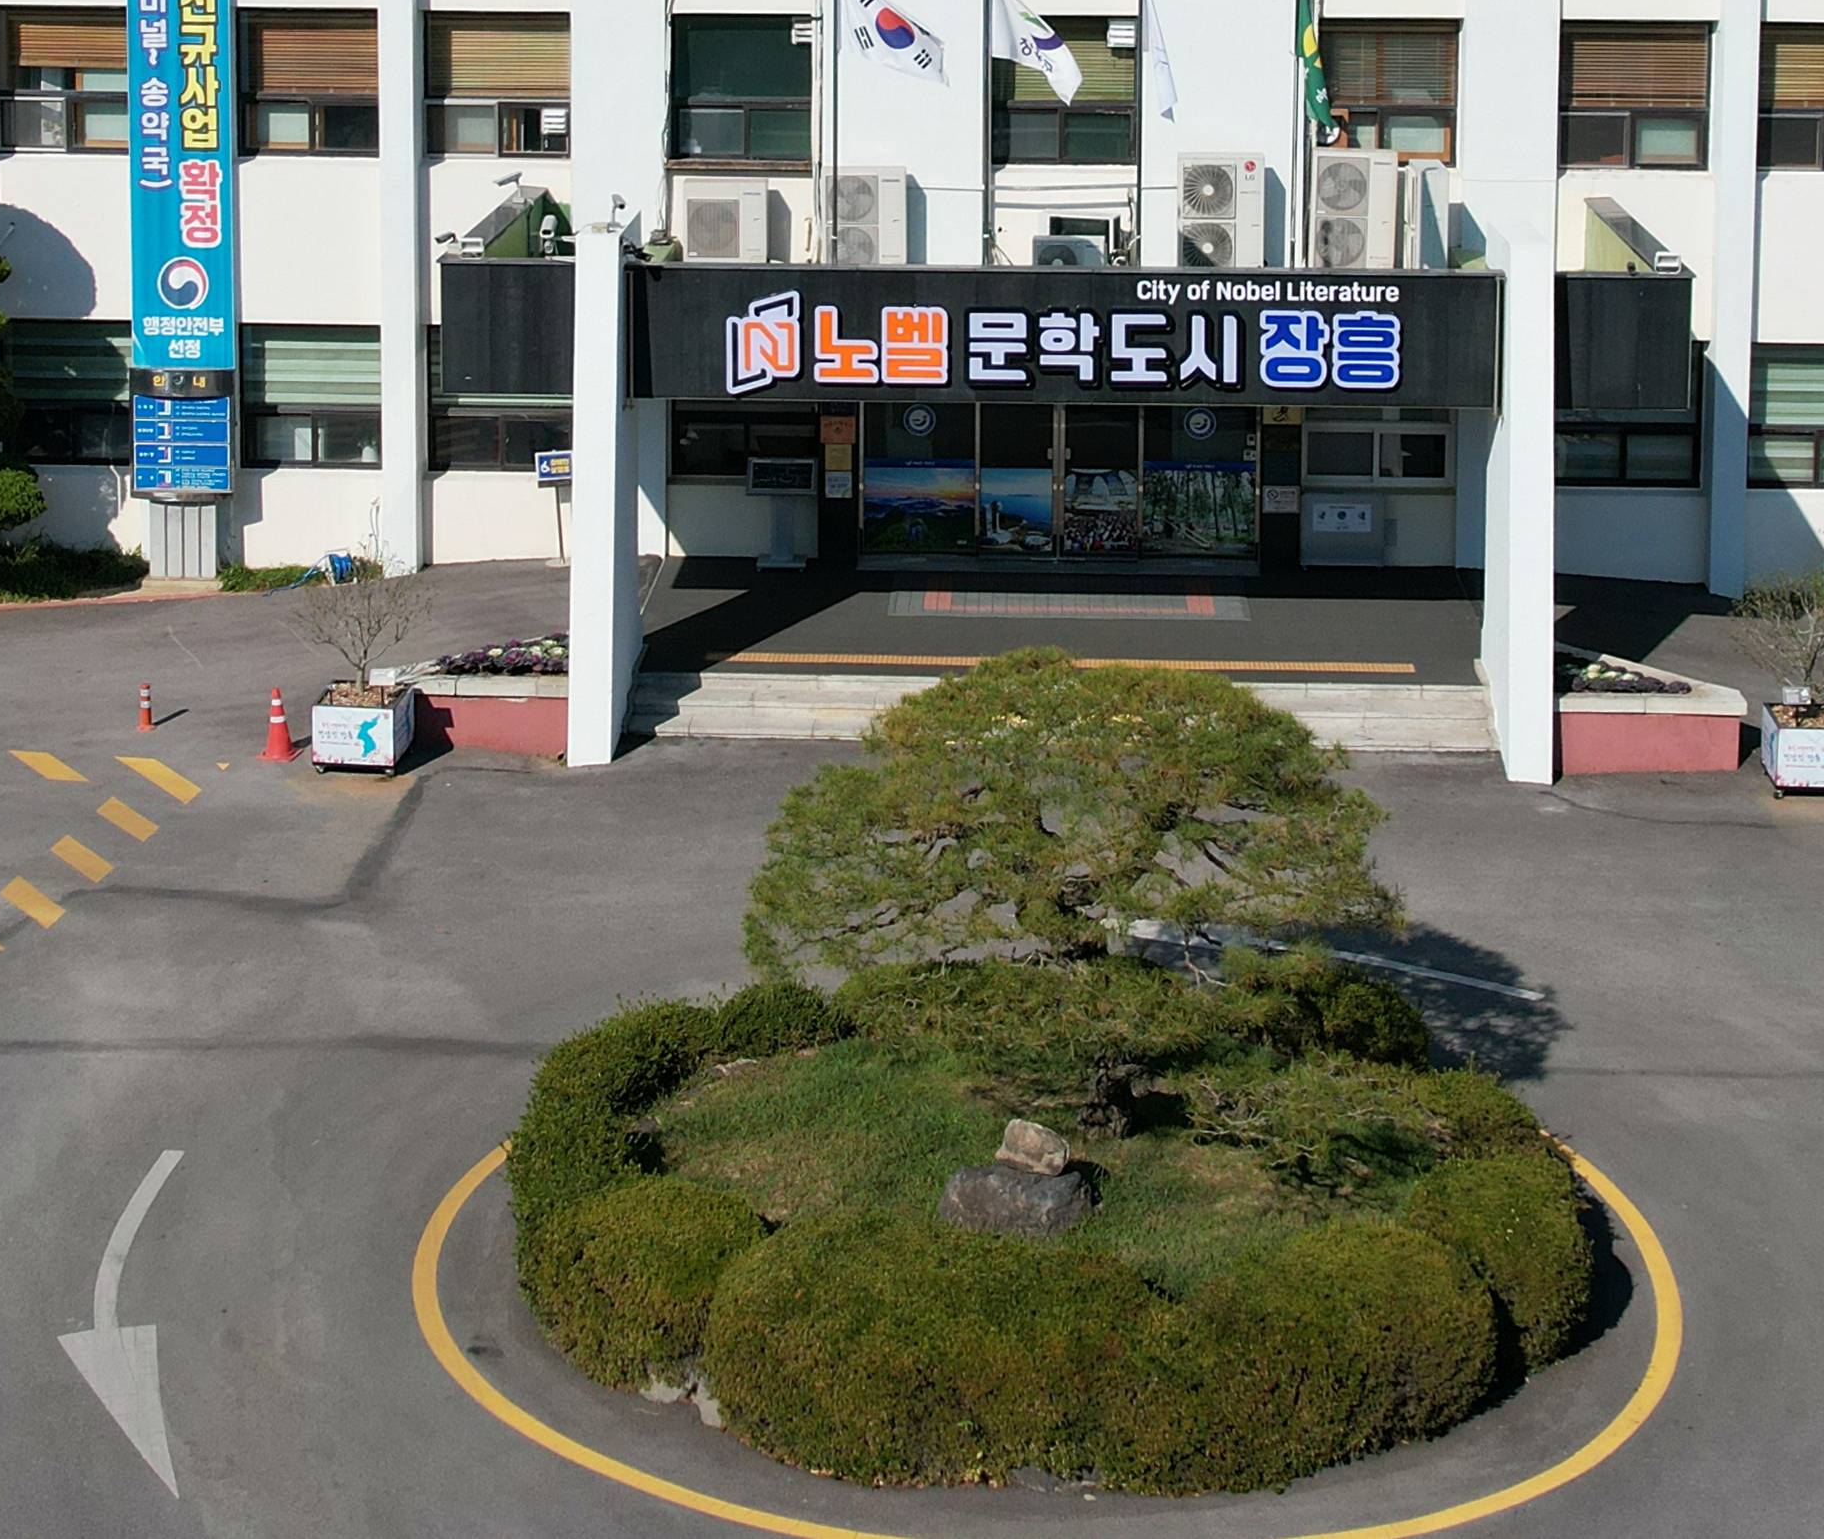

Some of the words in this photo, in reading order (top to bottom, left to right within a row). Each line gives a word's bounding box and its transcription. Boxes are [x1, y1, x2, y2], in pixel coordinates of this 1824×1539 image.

[137, 74, 173, 191] 송약국)
[179, 159, 223, 249] 확정
[1136, 279, 1180, 305] City
[1186, 279, 1211, 301] of
[1215, 279, 1281, 302] Nobel
[1286, 279, 1400, 302] Literature
[141, 315, 225, 337] 행정안전부
[168, 337, 202, 360] 선정
[813, 303, 950, 385] 노벨
[966, 309, 1239, 385] 문학도시
[1258, 308, 1402, 390] 장흥
